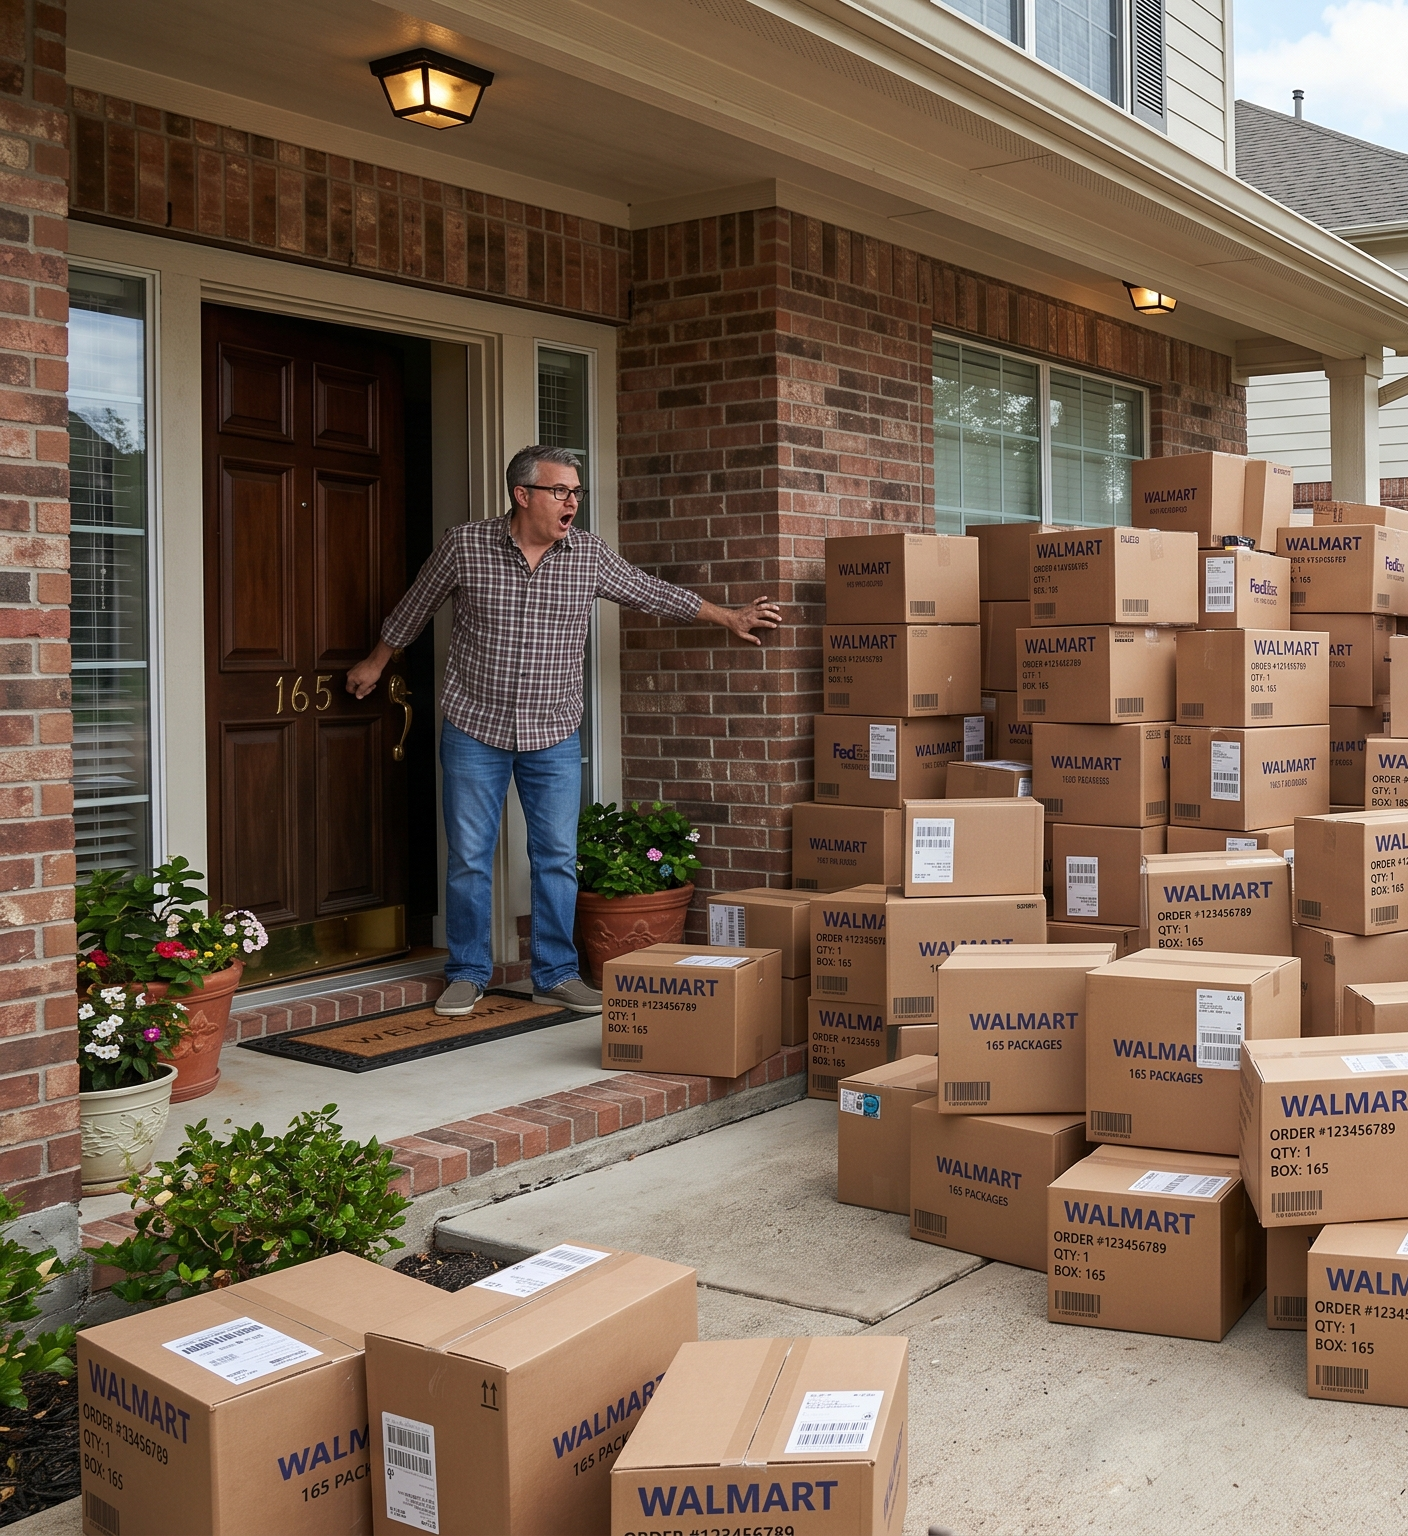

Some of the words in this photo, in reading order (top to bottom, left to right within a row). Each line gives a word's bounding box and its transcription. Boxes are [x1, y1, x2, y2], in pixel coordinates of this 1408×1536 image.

[1144, 488, 1197, 504] WALMART
[1036, 539, 1103, 559] WALMART
[1285, 536, 1362, 551] WALMART
[838, 561, 891, 576] WALMART
[829, 634, 897, 650] WALMART
[1024, 636, 1096, 654] WALMART
[1253, 639, 1320, 656] WALMART
[275, 674, 333, 714] 165
[915, 740, 962, 757] WALMART
[1051, 755, 1122, 771] WALMART
[1261, 757, 1317, 775] WALMART
[1372, 775, 1401, 784] ORDER
[1393, 787, 1398, 795] 1
[809, 838, 867, 853] WALMART
[1370, 859, 1396, 870] ORDER
[1370, 873, 1389, 884] QTY:
[1163, 880, 1274, 904] WALMART
[1371, 886, 1390, 896] BOX:
[1157, 908, 1192, 921] ORDER
[1194, 906, 1252, 919] #123456789
[816, 933, 843, 943] ORDER
[1157, 924, 1181, 936] QTY:
[1184, 924, 1189, 934] 1
[837, 946, 842, 955] 1
[1158, 938, 1184, 949] BOX:
[1186, 937, 1204, 947] 165
[816, 958, 836, 967] BOX:
[838, 958, 852, 967] 165
[615, 974, 719, 997] WALMART
[607, 998, 639, 1010] ORDER
[642, 999, 697, 1012] #123456789
[607, 1011, 630, 1022] QTY:
[969, 1012, 1079, 1031] WALMART
[607, 1023, 630, 1034] BOX:
[632, 1024, 648, 1035] 165
[812, 1032, 839, 1043] ORDER
[986, 1040, 1005, 1050] 165
[1007, 1040, 1063, 1050] PACKAGES
[831, 1046, 836, 1054] 1
[1129, 1068, 1147, 1080] 165
[1149, 1069, 1204, 1084] PACKAGES
[1270, 1126, 1316, 1142] ORDER
[1319, 1122, 1396, 1139] #123456789
[1270, 1146, 1302, 1160] QTY:
[1305, 1145, 1312, 1158] 1
[936, 1155, 1022, 1190] WALMART
[1270, 1164, 1302, 1178] BOX:
[1306, 1162, 1329, 1176] 165
[948, 1184, 963, 1197] 165
[965, 1188, 1009, 1207] PACKAGES
[1063, 1200, 1195, 1236] WALMART
[1053, 1231, 1094, 1246] ORDER
[1097, 1234, 1167, 1255] #123456789
[1053, 1248, 1082, 1262] QTY:
[1083, 1251, 1090, 1263] 1
[1054, 1265, 1082, 1279] BOX:
[1085, 1267, 1106, 1282] 165
[1314, 1300, 1361, 1316] ORDER
[1314, 1319, 1345, 1334] QTY:
[1349, 1322, 1356, 1335] 1
[1314, 1337, 1347, 1353] BOX:
[1351, 1341, 1375, 1355] 165
[88, 1359, 191, 1444] WALMART
[83, 1403, 113, 1434] ORDER
[83, 1429, 104, 1455] QTY:
[105, 1442, 110, 1458] 1
[84, 1453, 105, 1480] BOX:
[573, 1446, 597, 1477] 165
[301, 1473, 329, 1503] 165
[638, 1480, 838, 1517] WALMART
